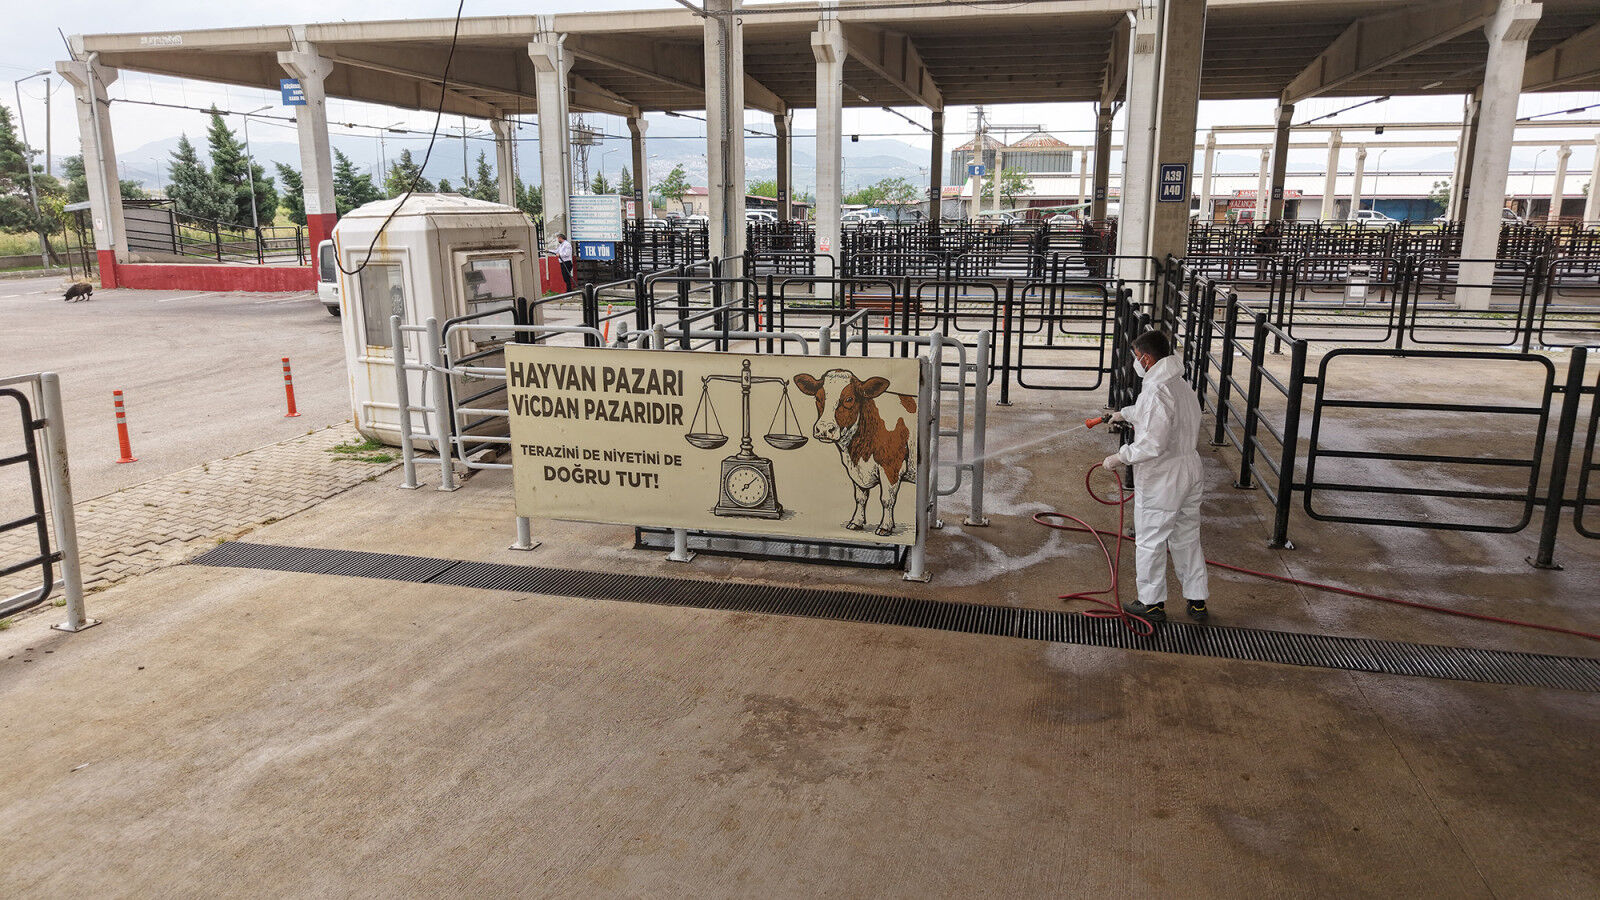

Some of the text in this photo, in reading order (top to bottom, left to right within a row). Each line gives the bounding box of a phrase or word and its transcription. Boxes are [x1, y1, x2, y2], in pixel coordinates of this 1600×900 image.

[974, 166, 980, 175] C
[1165, 170, 1182, 182] A39
[1163, 185, 1181, 196] A40
[584, 244, 611, 257] TEK YÖN
[509, 361, 684, 396] HAYVAN PAZARI
[584, 398, 684, 426] PAZARIDIR
[520, 444, 682, 466] TERAZİNİ DE NİYETİNİ DE
[543, 463, 659, 489] DOĞRU TUT!
